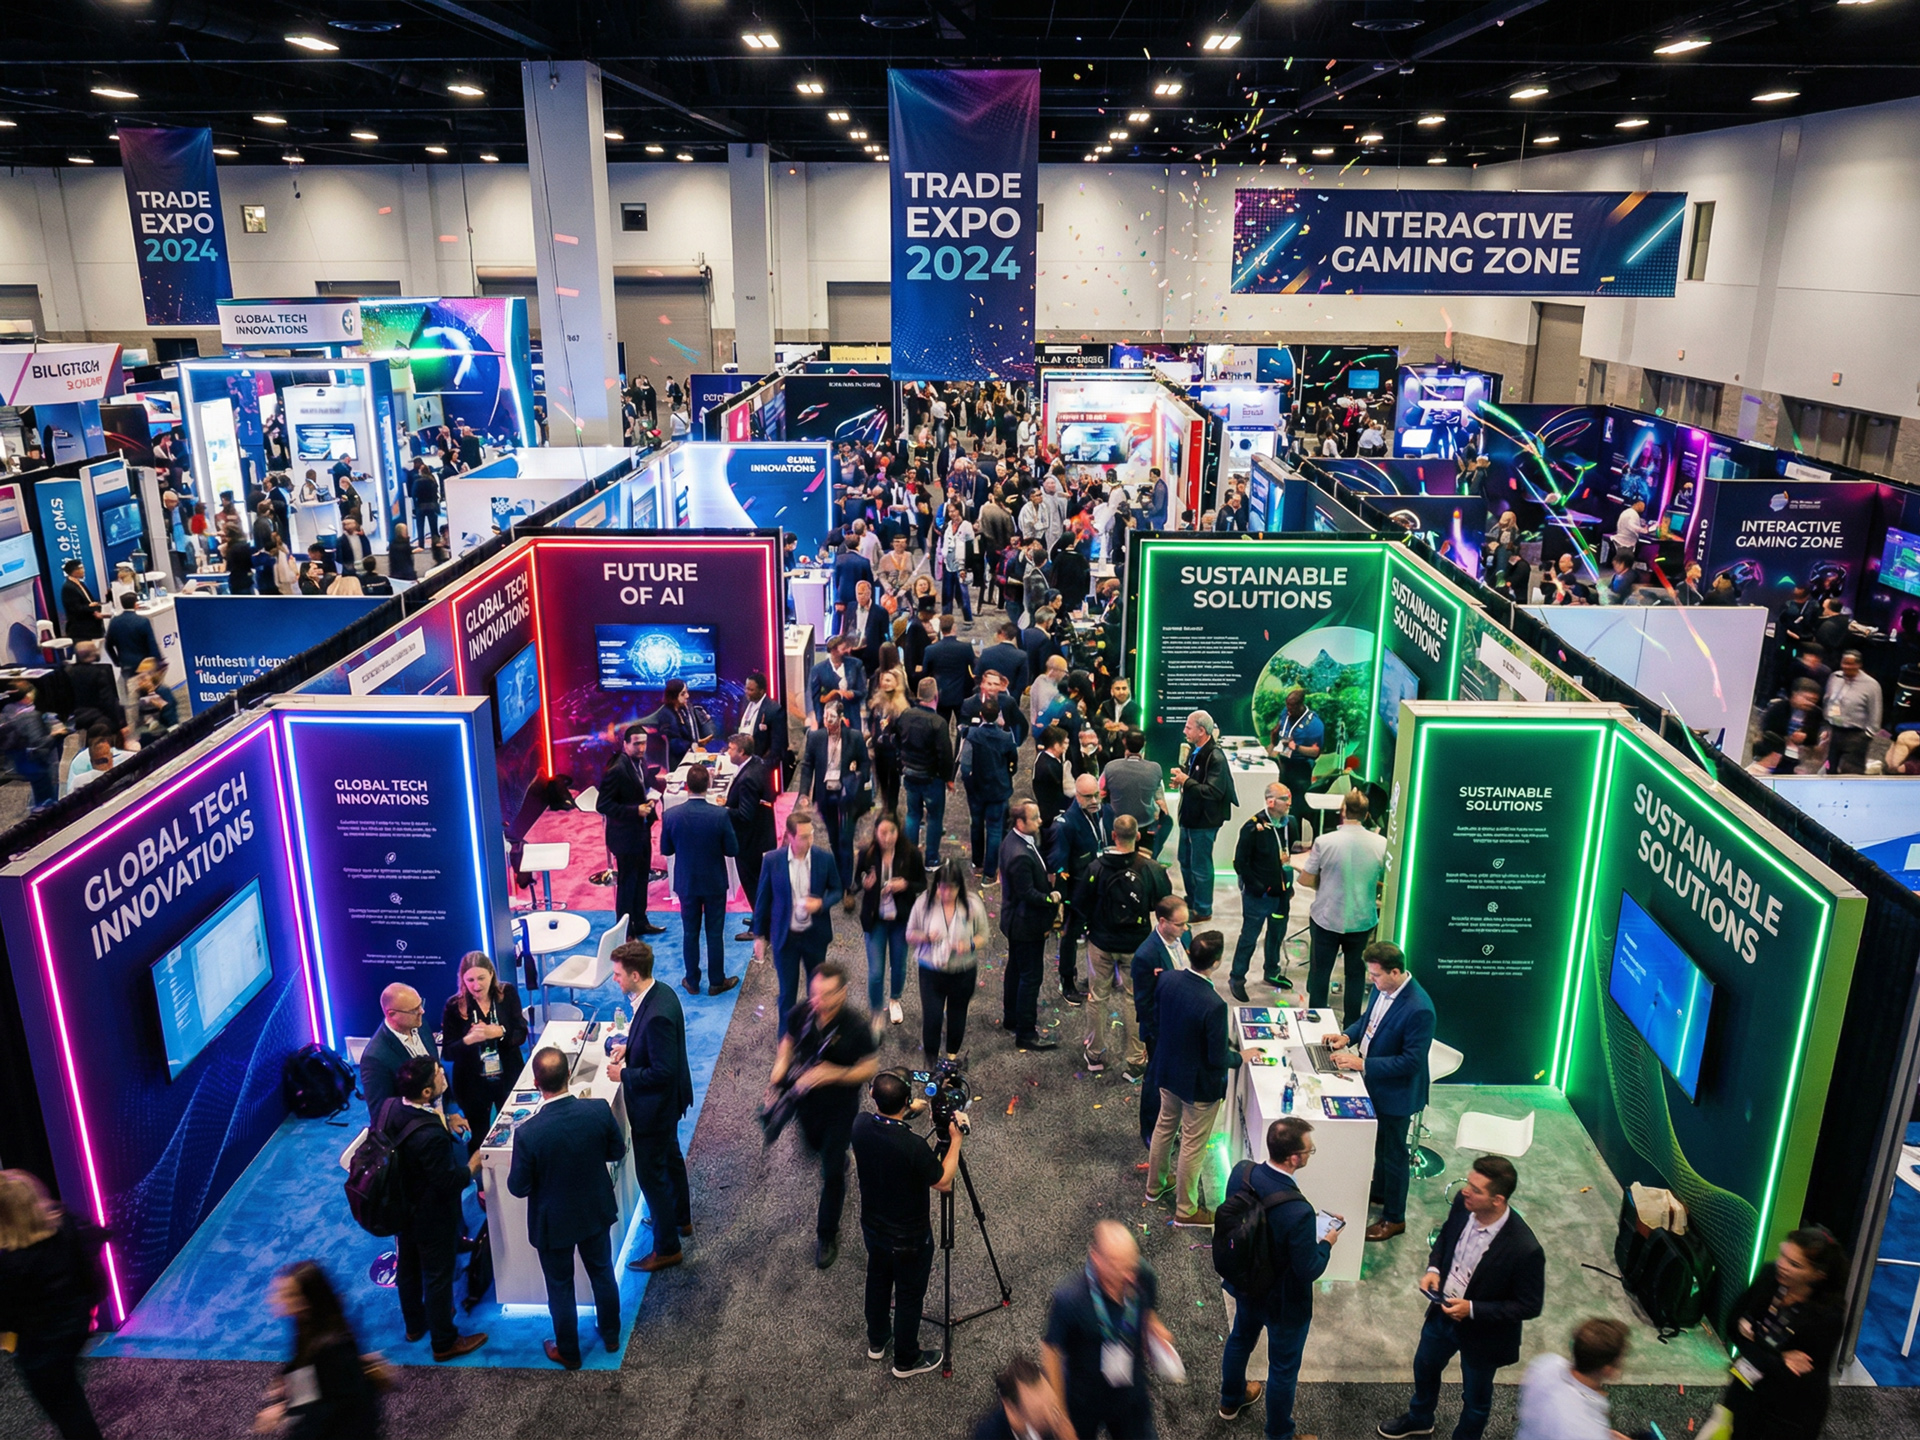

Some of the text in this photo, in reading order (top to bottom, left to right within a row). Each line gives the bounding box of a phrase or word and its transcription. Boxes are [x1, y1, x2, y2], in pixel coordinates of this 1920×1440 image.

[903, 171, 1022, 199] TRADE
[136, 191, 212, 209] TRADE
[140, 212, 215, 234] EXPO
[906, 206, 1021, 239] EXPO
[1344, 211, 1574, 240] INTERACTIVE
[143, 238, 219, 262] 2024
[1331, 246, 1581, 275] GAMING ZONE
[905, 245, 1021, 281] 2024
[234, 314, 307, 324] GLOBAL TECH
[236, 325, 309, 335] INNOVATIONS
[750, 464, 817, 473] INNOVATIONS
[1741, 520, 1842, 533] INTERACTIVE
[1735, 535, 1844, 549] GAMING ZONE
[603, 562, 699, 582] FUTURE
[1180, 566, 1348, 586] SUSTAINABLE
[465, 570, 529, 634] GLOBAL TECH
[619, 586, 684, 606] OF AI
[1193, 589, 1333, 610] SOLUTIONS
[1391, 577, 1449, 640] SUSTAINABLE
[468, 596, 530, 661] INNOVATIONS
[1393, 605, 1441, 663] SOLUTIONS
[334, 778, 428, 792] GLOBAL TECH
[1459, 786, 1553, 799] SUSTAINABLE
[336, 792, 430, 806] INNOVATIONS
[1465, 800, 1543, 812] SOLUTIONS
[84, 771, 248, 912] GLOBAL TECH
[1633, 783, 1784, 937] SUSTAINABLE
[91, 809, 255, 961] INNOVATIONS
[1637, 830, 1760, 965] SOLUTIONS
